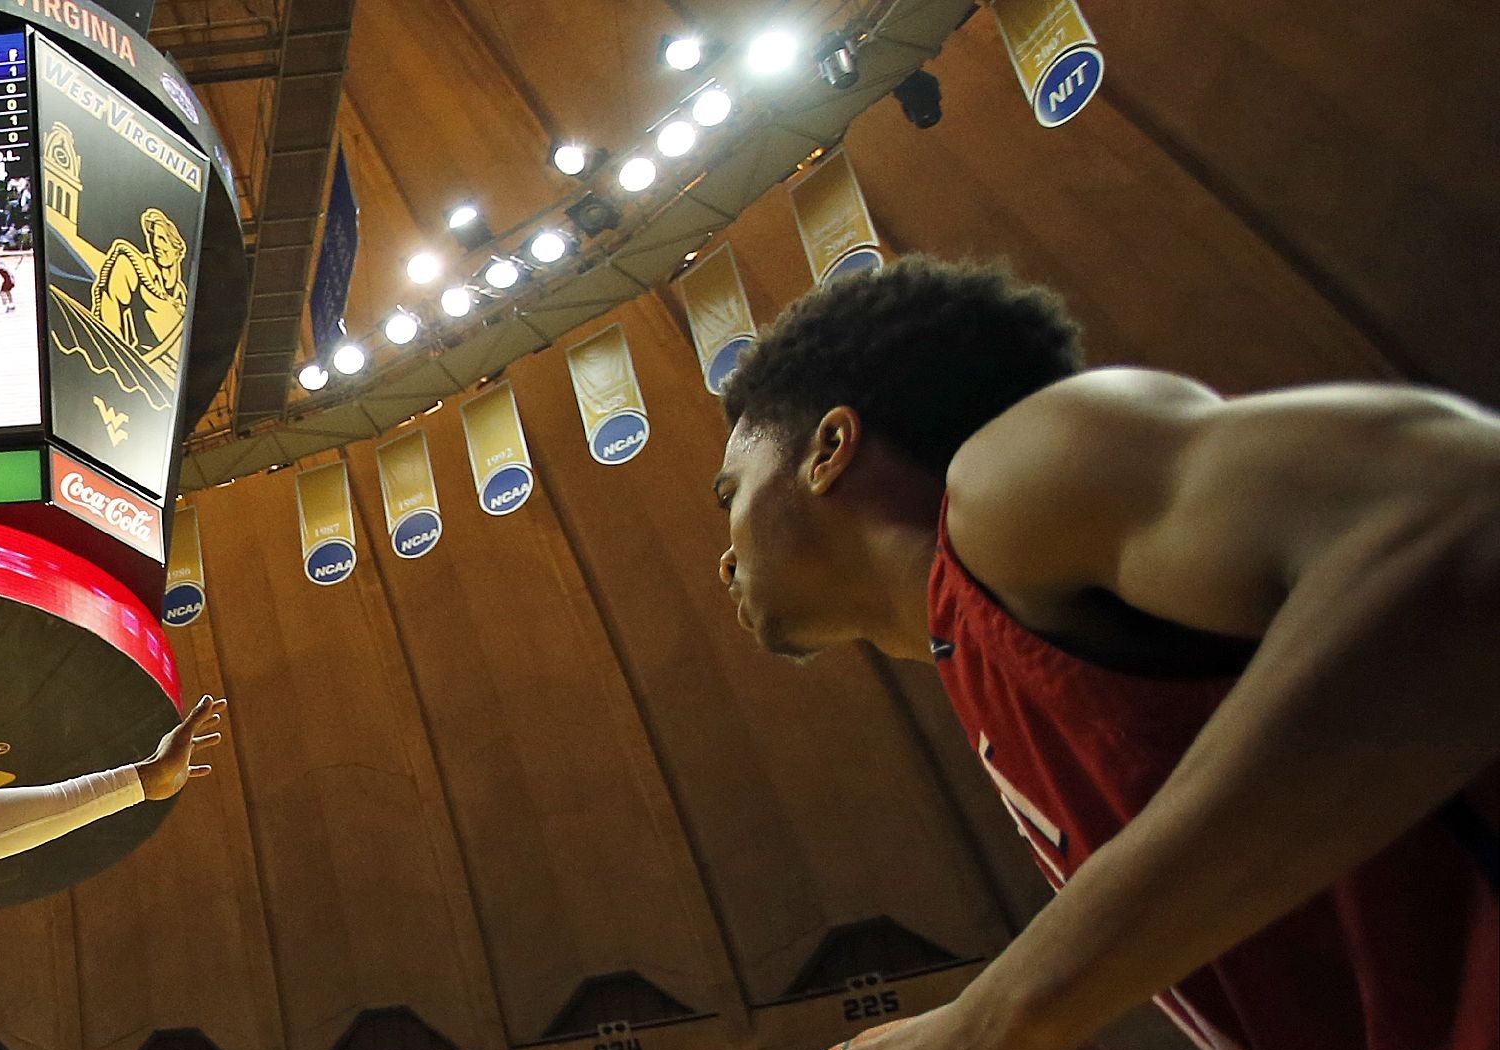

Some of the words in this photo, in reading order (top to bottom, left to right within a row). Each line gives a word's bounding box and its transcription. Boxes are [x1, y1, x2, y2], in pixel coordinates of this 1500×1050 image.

[9, 66, 17, 76] 1
[6, 83, 16, 93] 0
[1049, 60, 1089, 113] NIT
[7, 99, 17, 110] 0
[10, 115, 18, 125] 1
[45, 54, 104, 115] WEST
[110, 101, 198, 186] VIRGINIA
[8, 132, 18, 143] 0
[602, 429, 645, 458] NCAA
[60, 472, 153, 542] Coca-Cola
[490, 482, 531, 510] NCAA
[400, 527, 440, 553] NCAA
[314, 558, 354, 578] NCAA
[167, 602, 202, 619] NCAA
[843, 990, 899, 1021] 225
